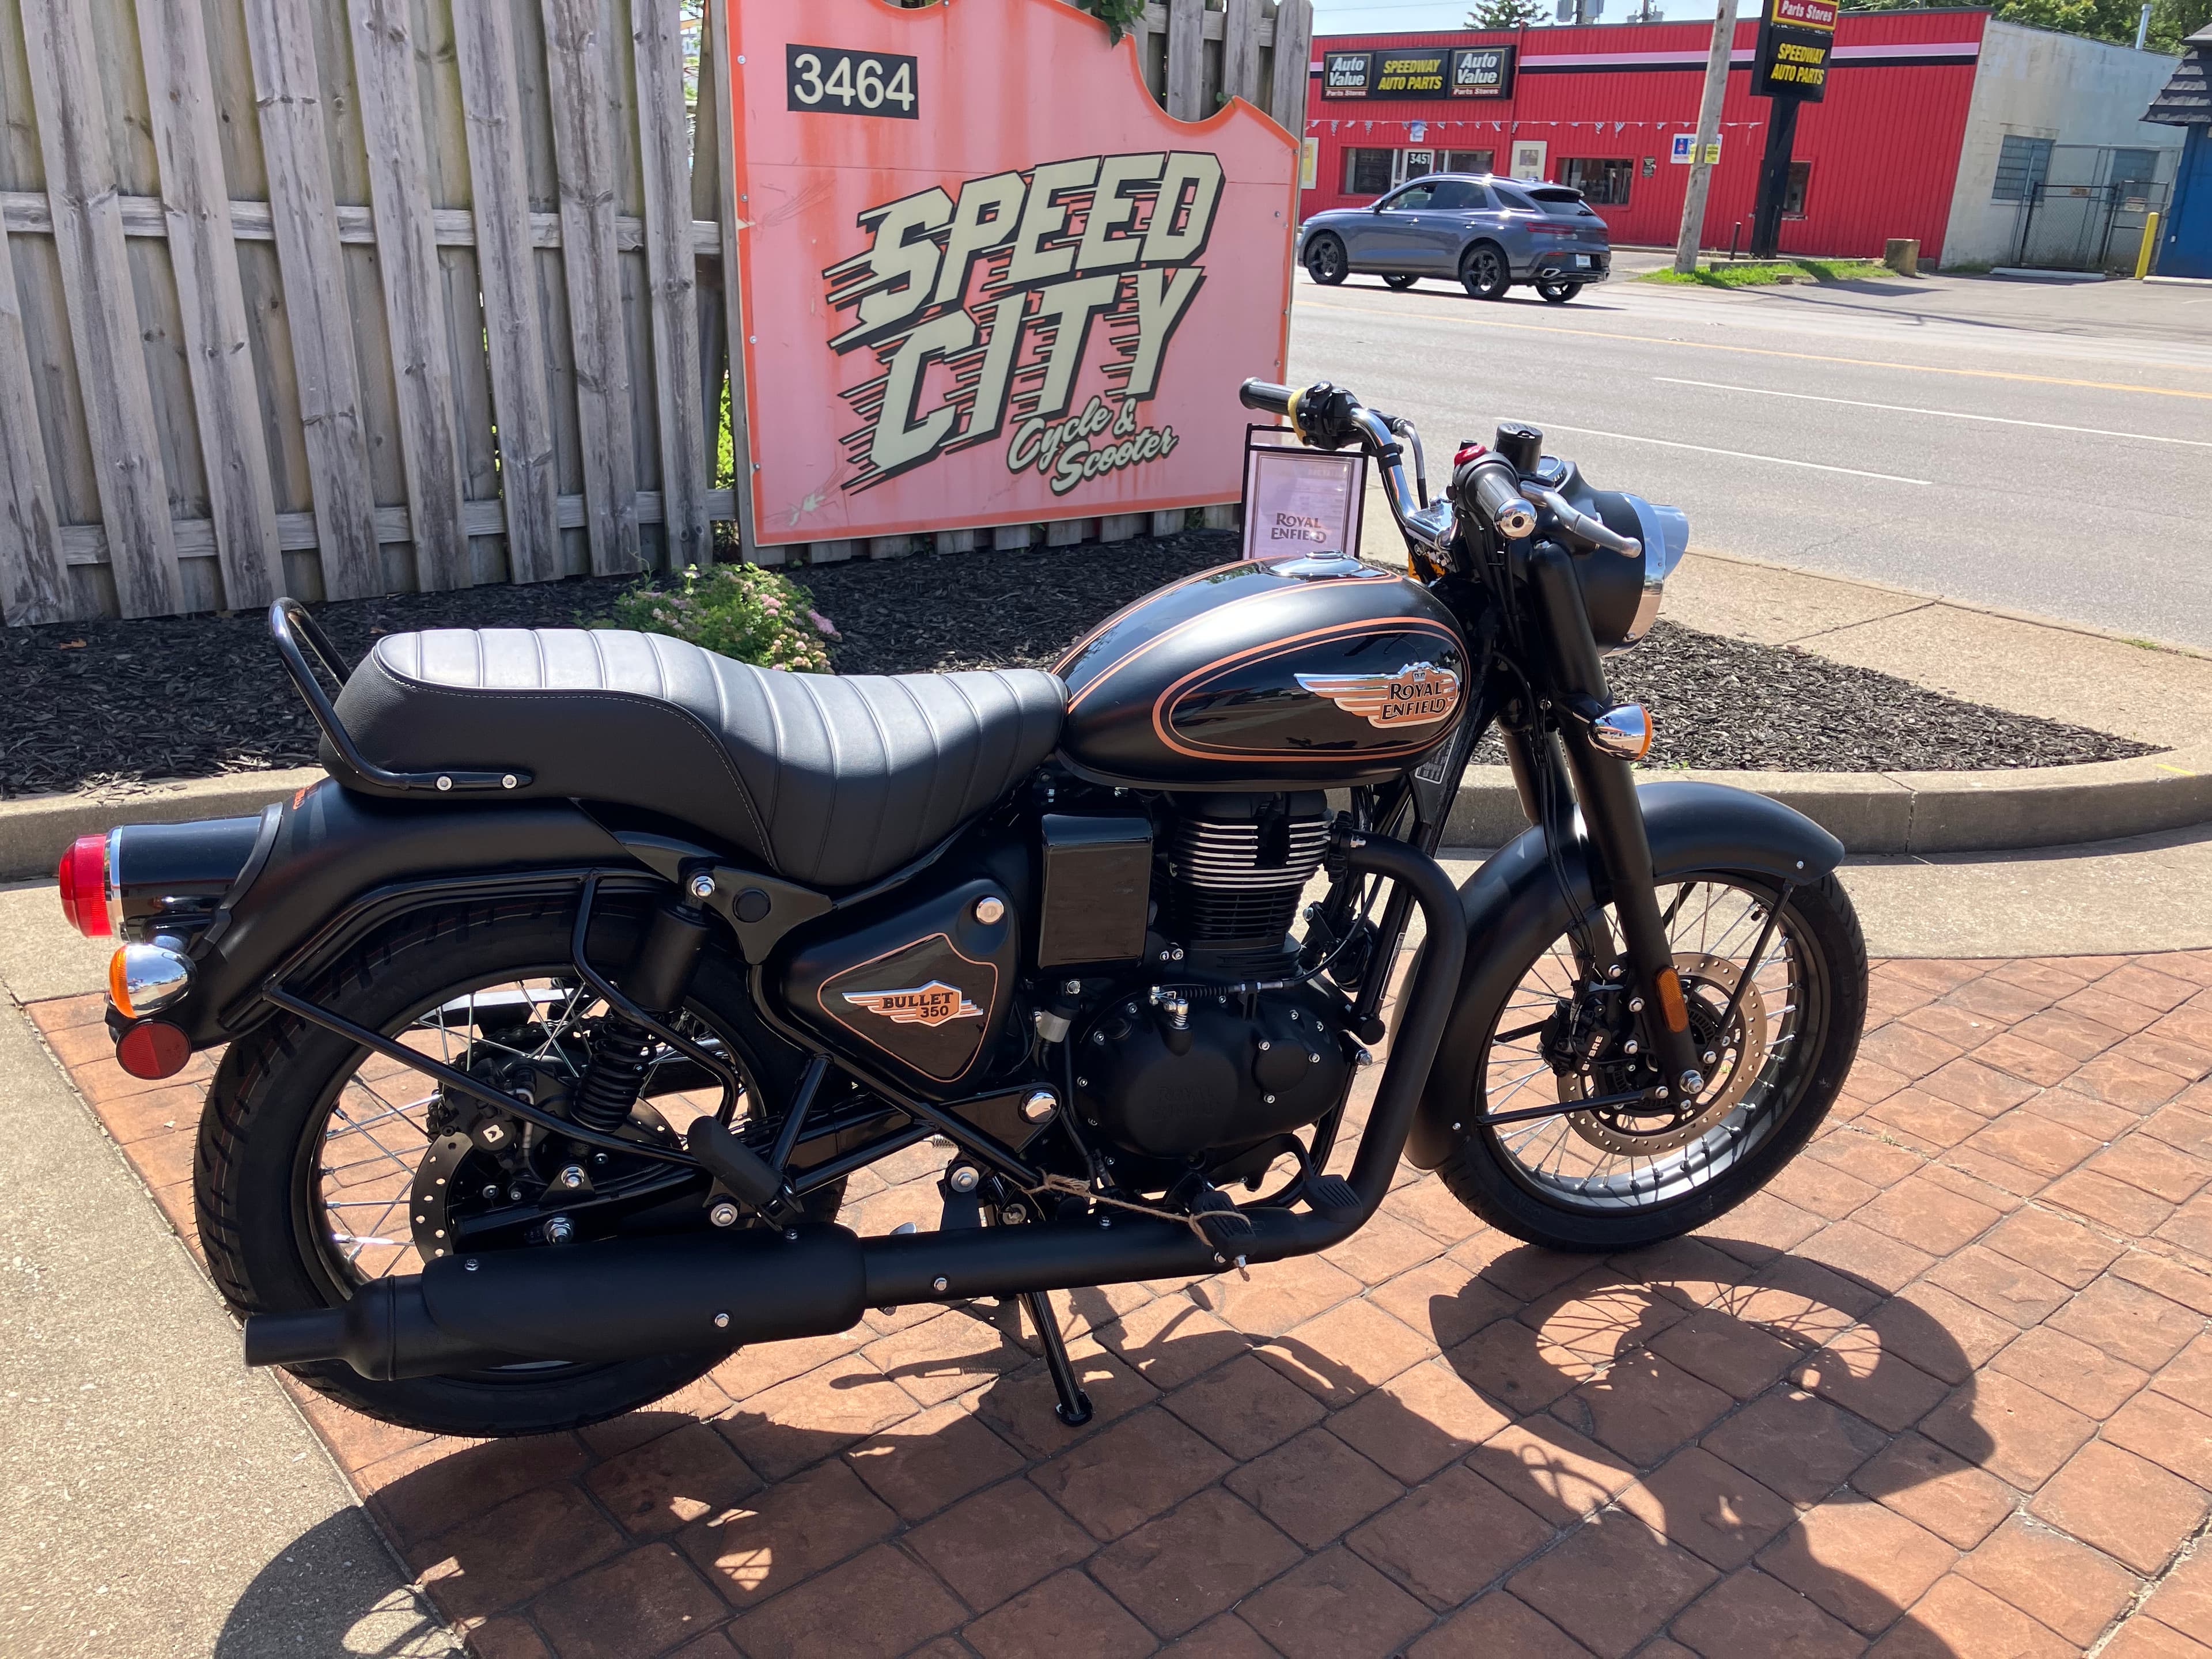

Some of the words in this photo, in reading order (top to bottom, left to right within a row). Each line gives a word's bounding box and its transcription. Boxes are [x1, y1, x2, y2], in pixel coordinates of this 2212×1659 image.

[1781, 0, 1805, 17] Parts
[1806, 5, 1832, 22] Stores
[1460, 52, 1498, 69] Auto
[1778, 43, 1825, 63] SPEEDWAY
[1331, 56, 1365, 71] Auto
[1383, 59, 1441, 74] SPEEDWAY
[792, 52, 916, 112] 3464
[1329, 71, 1365, 86] Value
[1377, 77, 1407, 90] AUTO
[1407, 75, 1443, 90] PARTS
[1457, 69, 1498, 84] Value
[1771, 63, 1797, 82] AUTO
[1796, 67, 1825, 85] PARTS
[1410, 153, 1430, 165] 3451
[824, 150, 1226, 353] SPEED
[842, 266, 1207, 490] CITY
[1007, 397, 1112, 476] Cycle
[1113, 397, 1136, 438] &
[1050, 425, 1179, 495] Scooter
[1276, 512, 1321, 529] ROYAL
[1389, 681, 1443, 700] ROYAL
[1381, 698, 1446, 721] ENFIELD
[881, 991, 954, 1009] BULLET
[920, 1006, 949, 1018] 350
